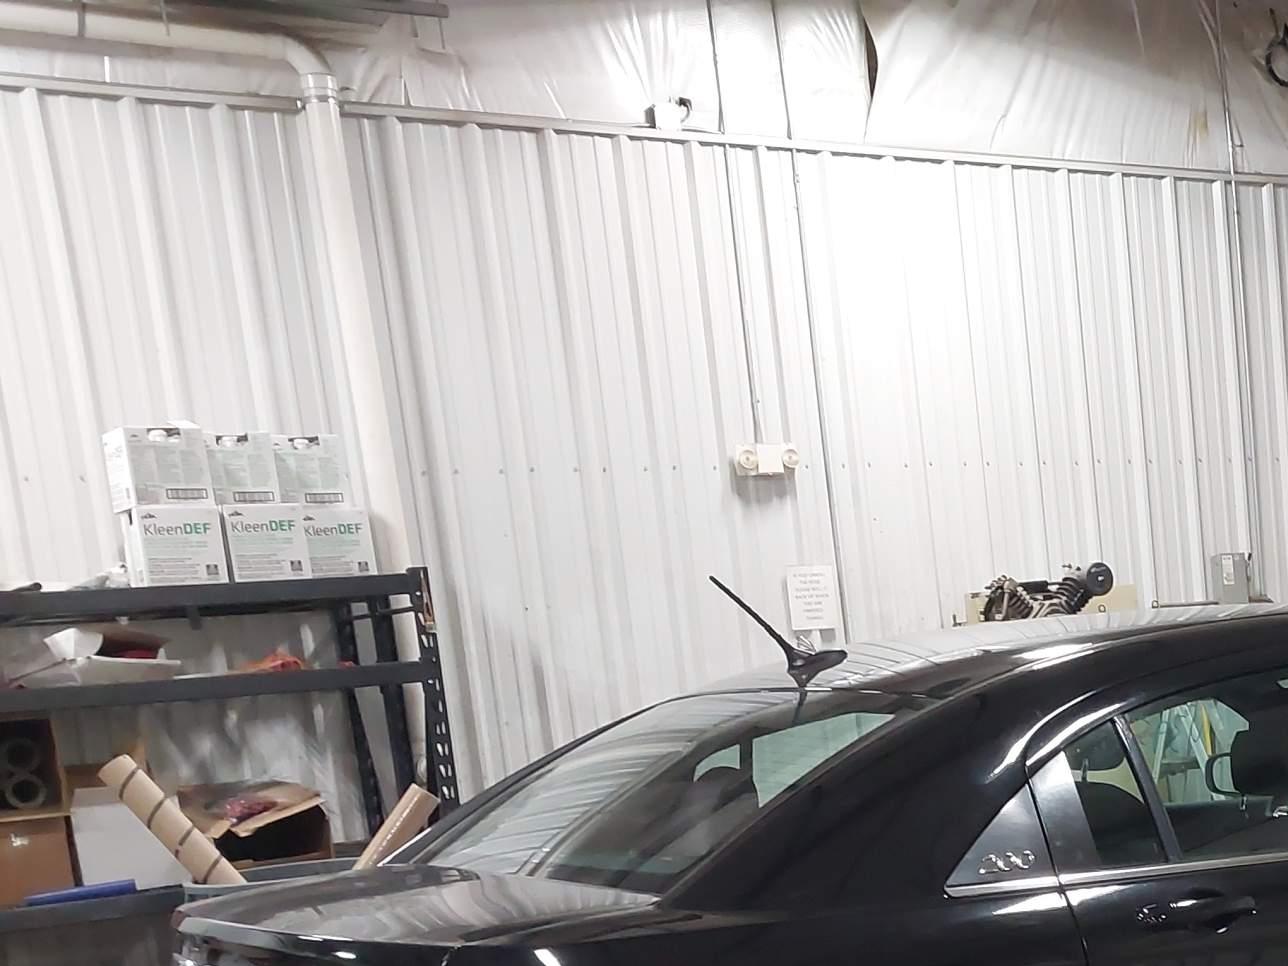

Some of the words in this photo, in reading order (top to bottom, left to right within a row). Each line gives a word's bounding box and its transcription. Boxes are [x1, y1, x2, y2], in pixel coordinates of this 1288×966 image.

[143, 522, 211, 536] KleenDEF
[230, 519, 295, 533] KleenDEF
[303, 523, 363, 537] KleenDEF
[979, 850, 1035, 874] 200
